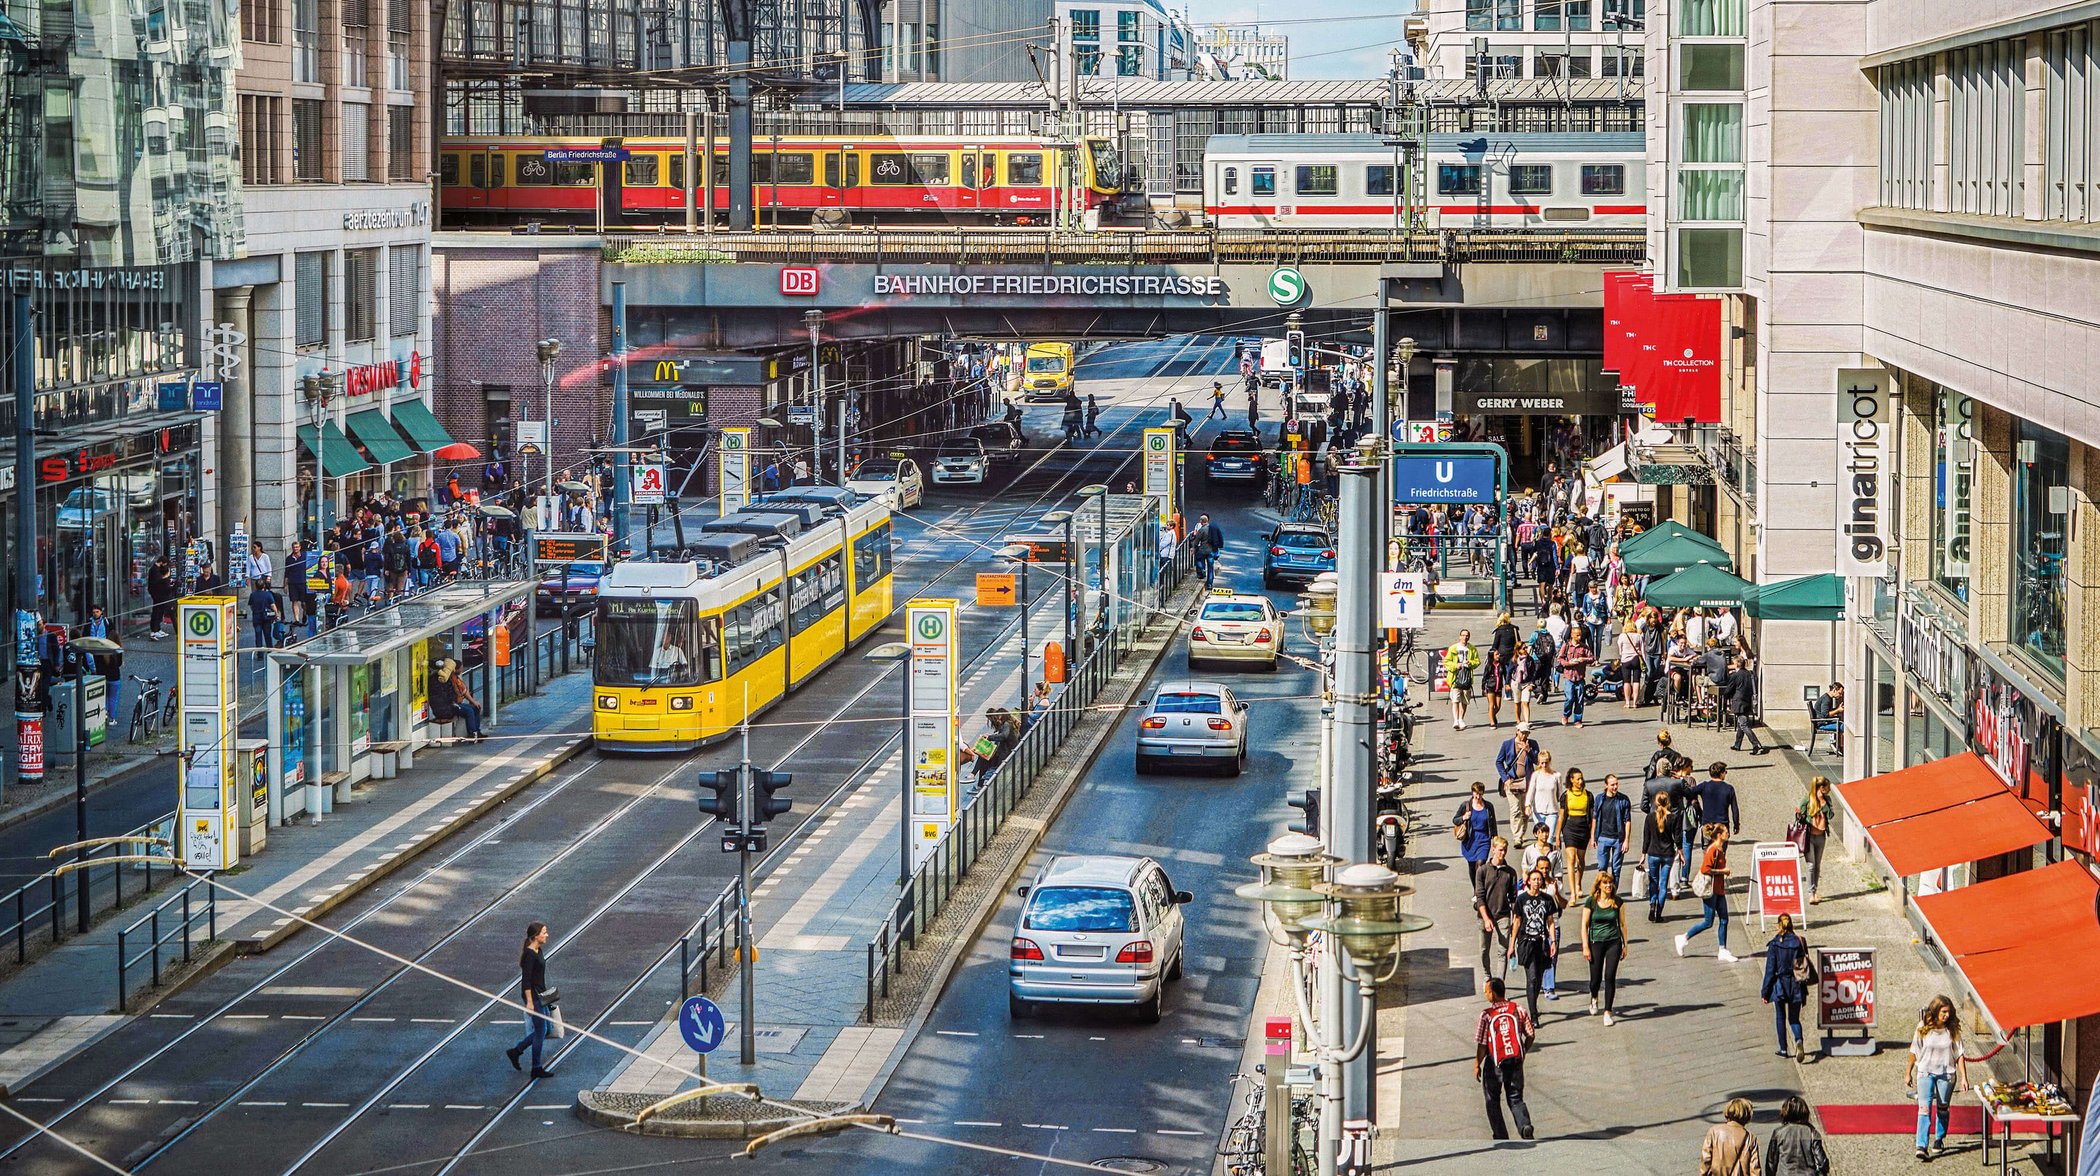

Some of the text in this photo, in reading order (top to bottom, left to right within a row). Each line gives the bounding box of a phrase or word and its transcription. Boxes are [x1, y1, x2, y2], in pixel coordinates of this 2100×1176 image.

[548, 151, 617, 159] Berlin Friedrichstraße
[786, 272, 813, 290] DB
[874, 275, 1221, 295] BAHNHOF FRIEDRICHSTRASSE
[1271, 270, 1301, 301] S
[346, 359, 398, 397] ROSSMANN
[633, 391, 666, 399] WILLKOMMEN
[666, 391, 675, 399] BEI
[1476, 398, 1565, 409] GERRY WEBER
[1435, 461, 1454, 483] U
[1844, 384, 1884, 563] ginatricot
[1410, 487, 1478, 498] Friedrichstraße
[1393, 578, 1413, 590] dm
[1765, 874, 1794, 885] FINAL
[1766, 886, 1795, 898] SALE
[1830, 952, 1860, 964] LAGER
[1822, 979, 1874, 1004] 50%
[1832, 1005, 1865, 1015] RADIKAL
[1831, 1011, 1869, 1022] REDUZIERT
